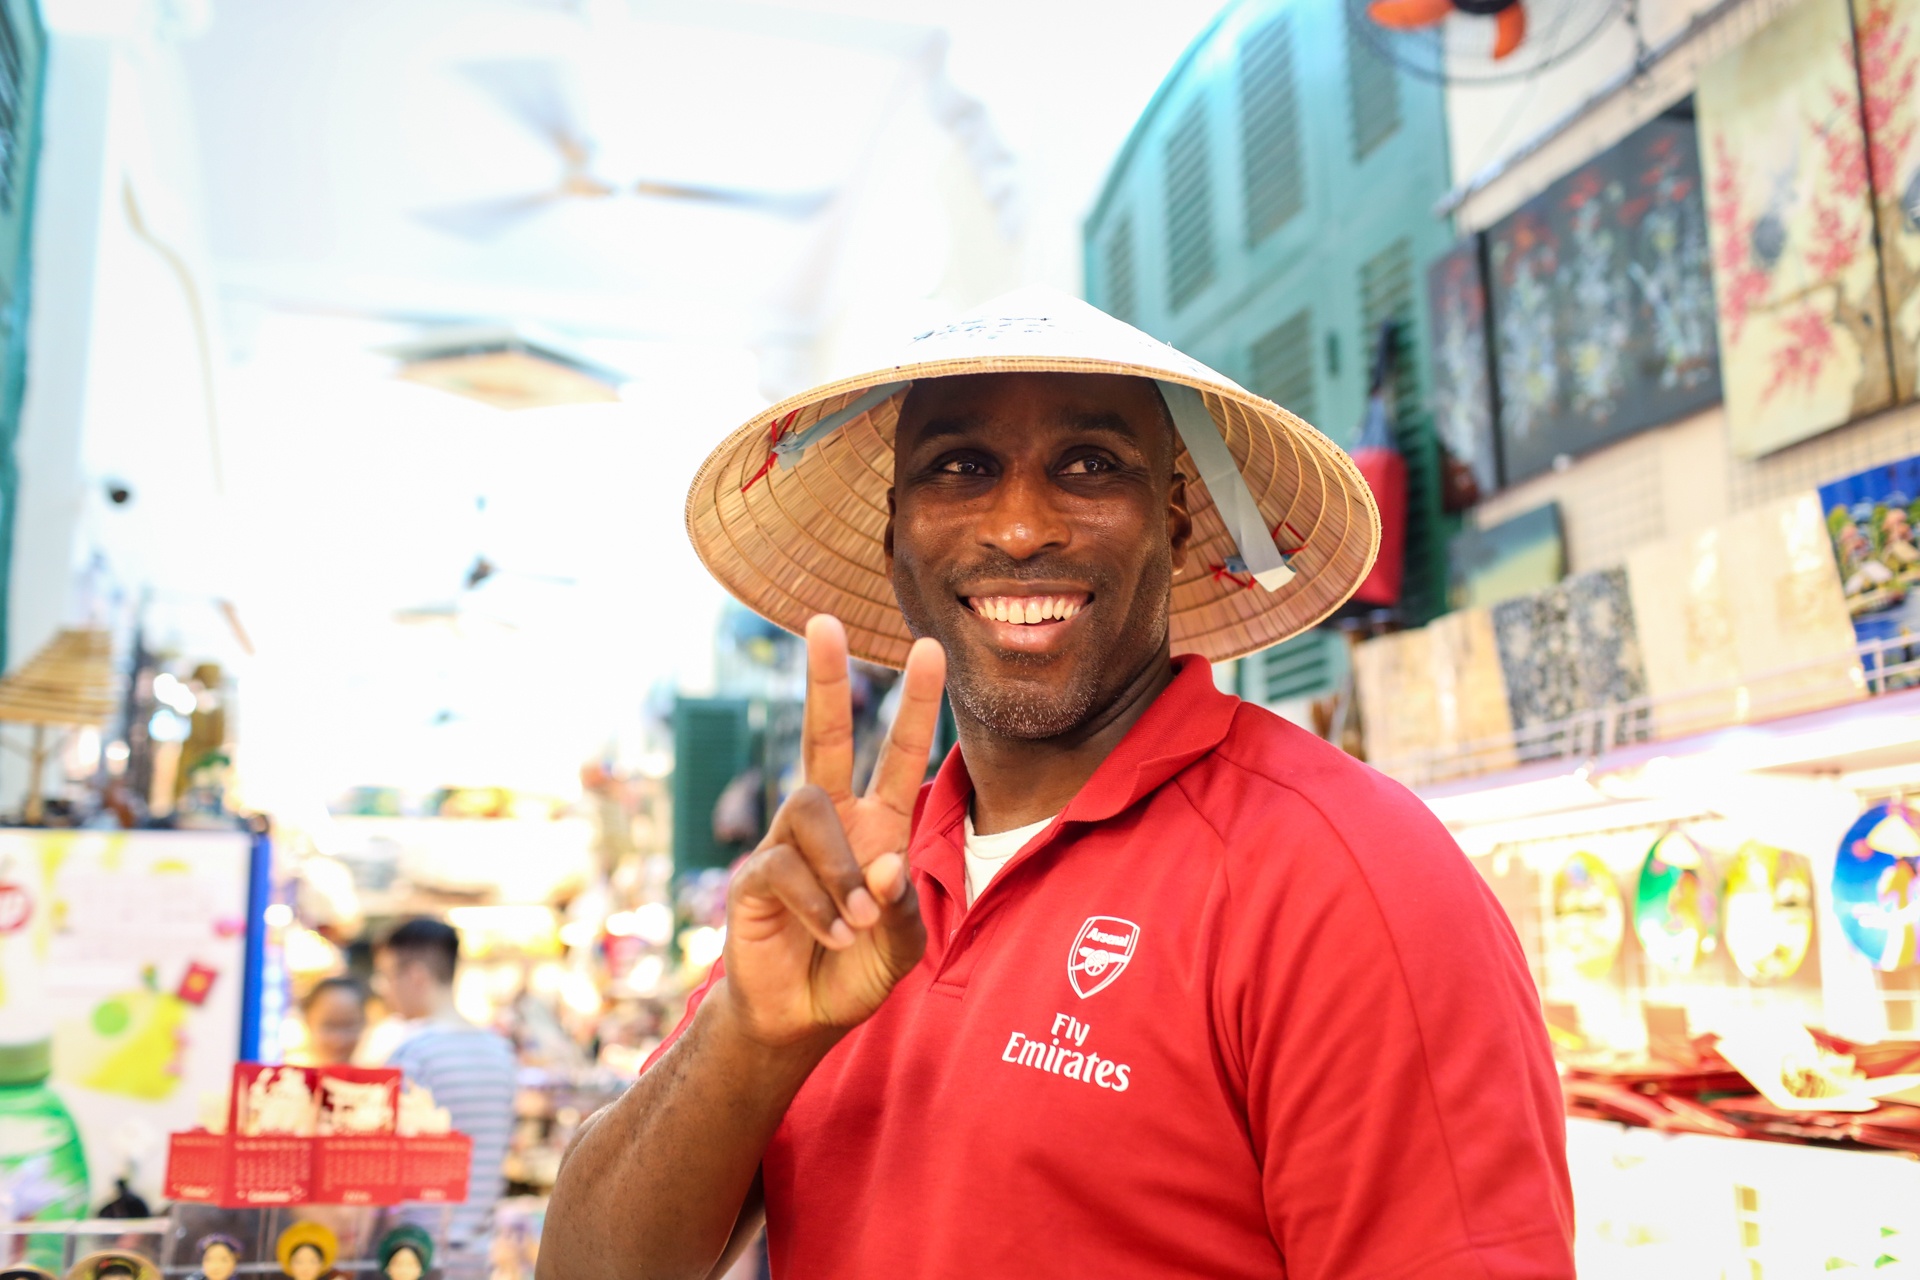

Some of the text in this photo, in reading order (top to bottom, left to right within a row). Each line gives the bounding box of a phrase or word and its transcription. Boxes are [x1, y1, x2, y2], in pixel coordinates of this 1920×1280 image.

[1086, 927, 1130, 947] Arsenal
[1051, 1012, 1090, 1047] Fly
[1001, 1031, 1131, 1092] Emirates
